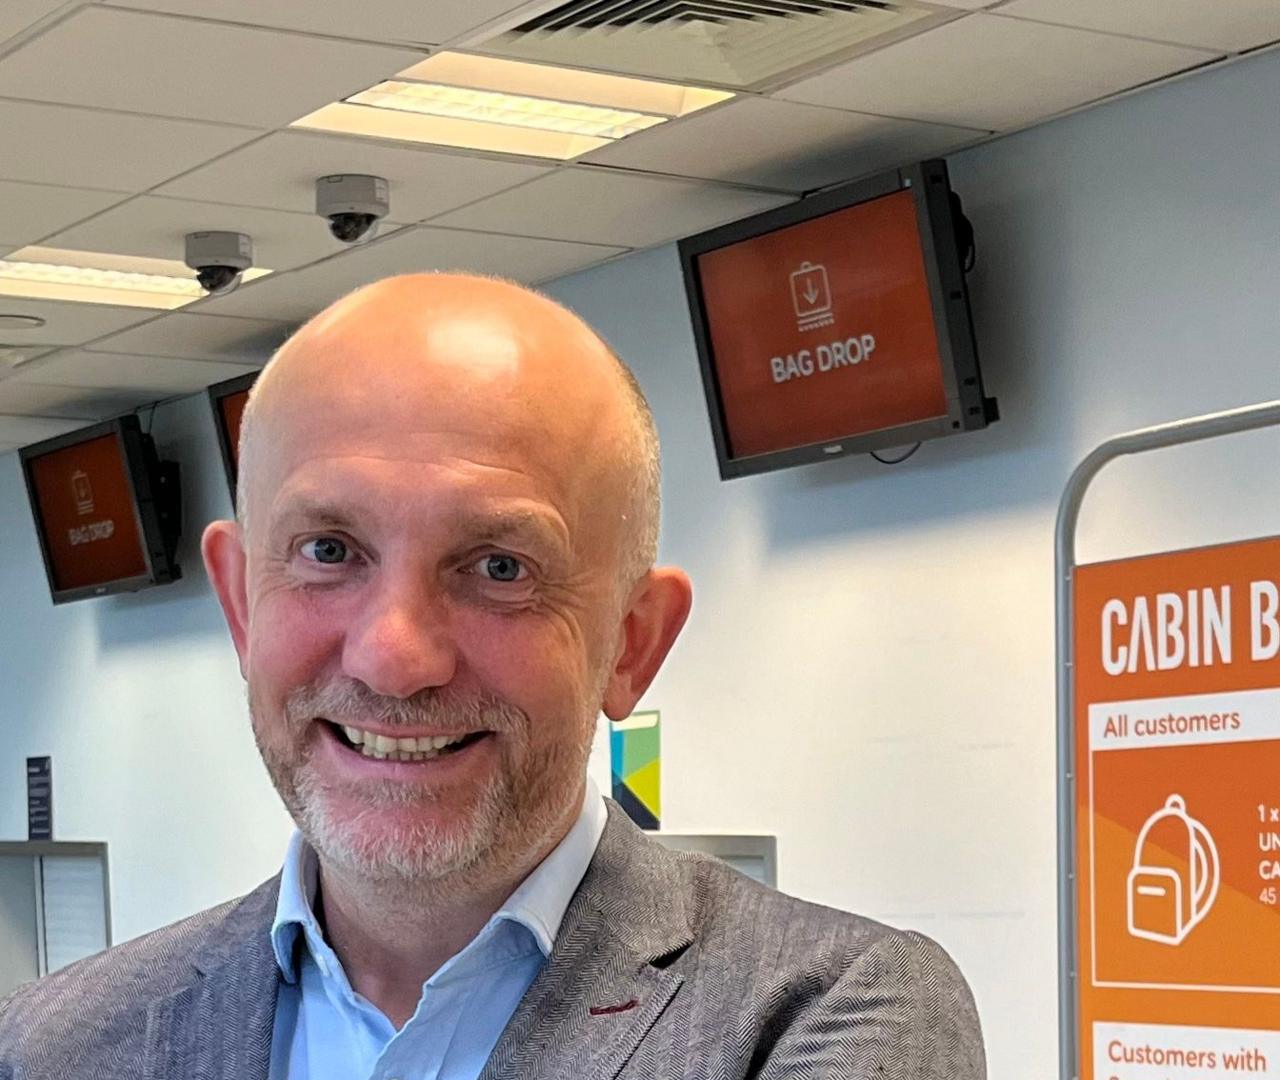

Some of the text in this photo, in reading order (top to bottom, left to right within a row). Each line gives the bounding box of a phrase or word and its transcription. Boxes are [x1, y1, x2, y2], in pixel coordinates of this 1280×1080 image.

[770, 333, 876, 384] BAG DROP
[1101, 584, 1232, 675] CABIN
[1103, 709, 1240, 738] All customers
[1258, 804, 1266, 822] 1
[1270, 809, 1279, 822] x
[1259, 887, 1277, 905] 45
[1108, 1041, 1266, 1072] Customers with
